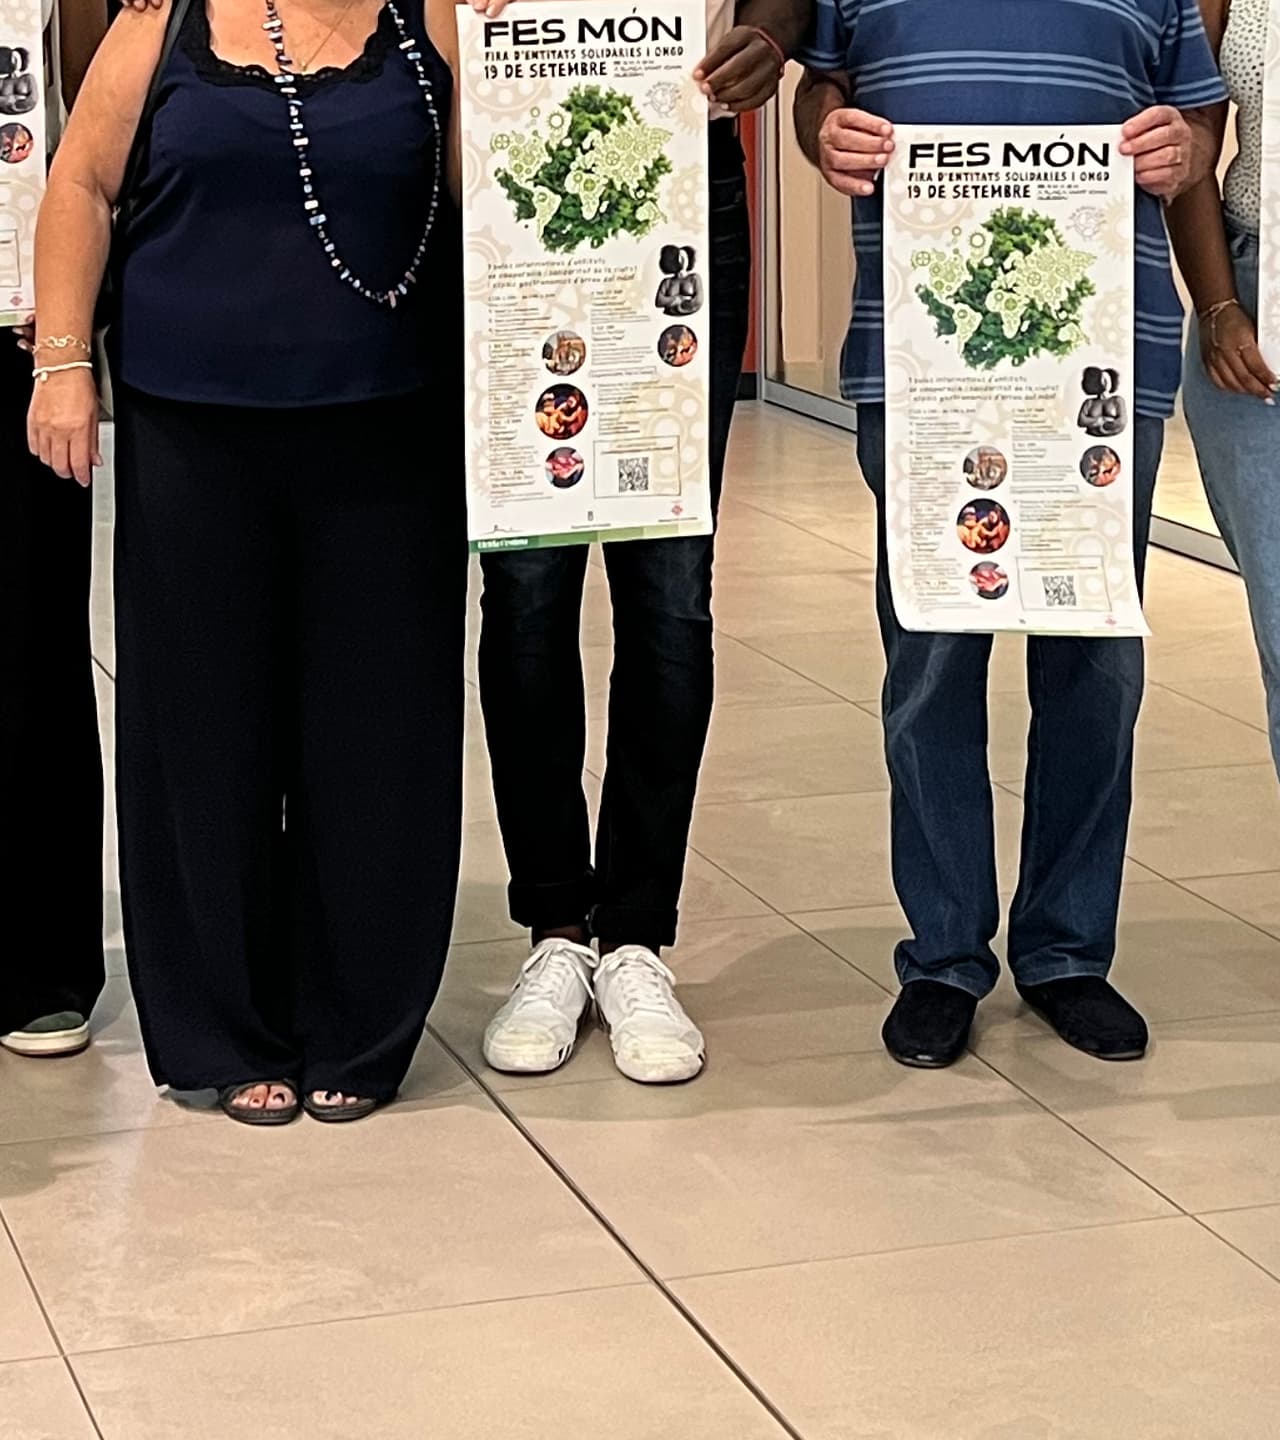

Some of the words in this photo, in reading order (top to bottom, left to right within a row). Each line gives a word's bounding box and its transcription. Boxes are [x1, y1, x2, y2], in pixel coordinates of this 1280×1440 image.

[483, 16, 566, 48] FES
[577, 7, 682, 44] MÓN
[484, 50, 509, 62] FIRA
[513, 48, 576, 61] D'ENTITATS
[484, 64, 499, 80] 19
[504, 63, 524, 80] DE
[529, 60, 608, 79] SETEMBRE
[908, 141, 991, 169] FES
[1001, 133, 1110, 168] MÓN
[908, 171, 933, 182] FIRA
[937, 171, 1001, 183] D'ENTITATS
[907, 184, 922, 200] 19
[927, 184, 947, 200] DE
[952, 183, 1032, 200] SETEMBRE
